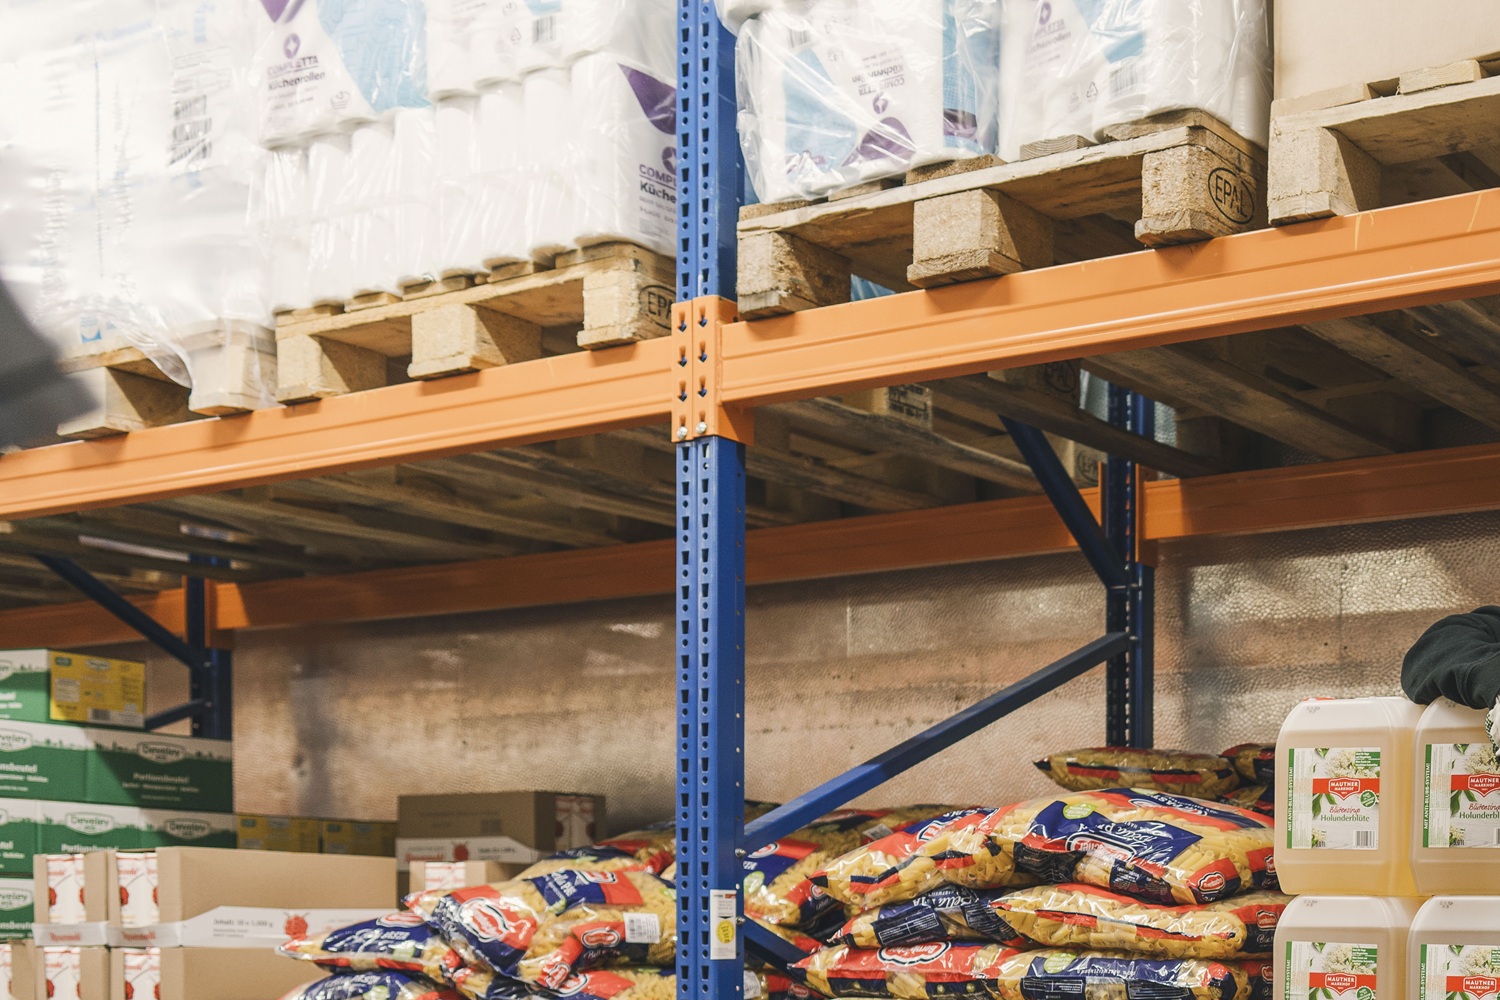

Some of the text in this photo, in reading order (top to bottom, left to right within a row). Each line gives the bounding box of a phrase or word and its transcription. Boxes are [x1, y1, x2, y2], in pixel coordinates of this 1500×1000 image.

[639, 163, 676, 186] COMPL
[1215, 174, 1248, 218] EPAL
[647, 291, 673, 320] EPA
[1320, 814, 1370, 822] Holunderblüte
